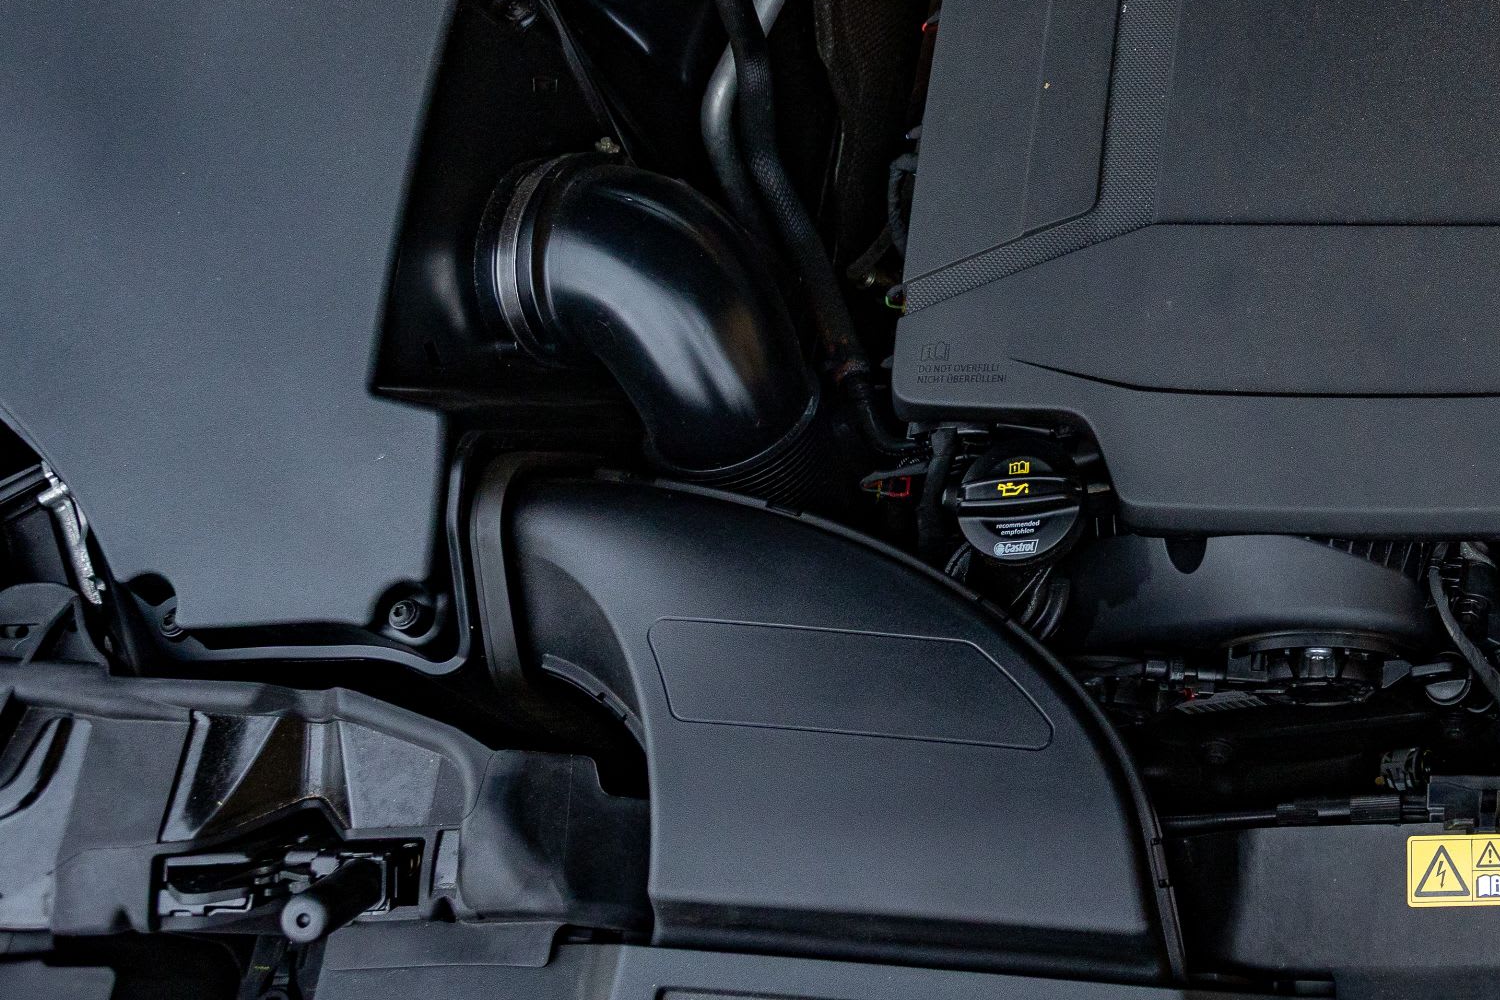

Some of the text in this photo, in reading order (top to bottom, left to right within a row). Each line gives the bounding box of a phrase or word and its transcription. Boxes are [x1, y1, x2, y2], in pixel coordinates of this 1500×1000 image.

[918, 363, 1000, 373] DO NOT OVERFILL!
[916, 372, 1007, 384] NICHT ÜBERFÜLLEN!
[996, 519, 1040, 530] recommended
[1000, 528, 1035, 537] empfohlen
[1004, 541, 1035, 554] Castrol
